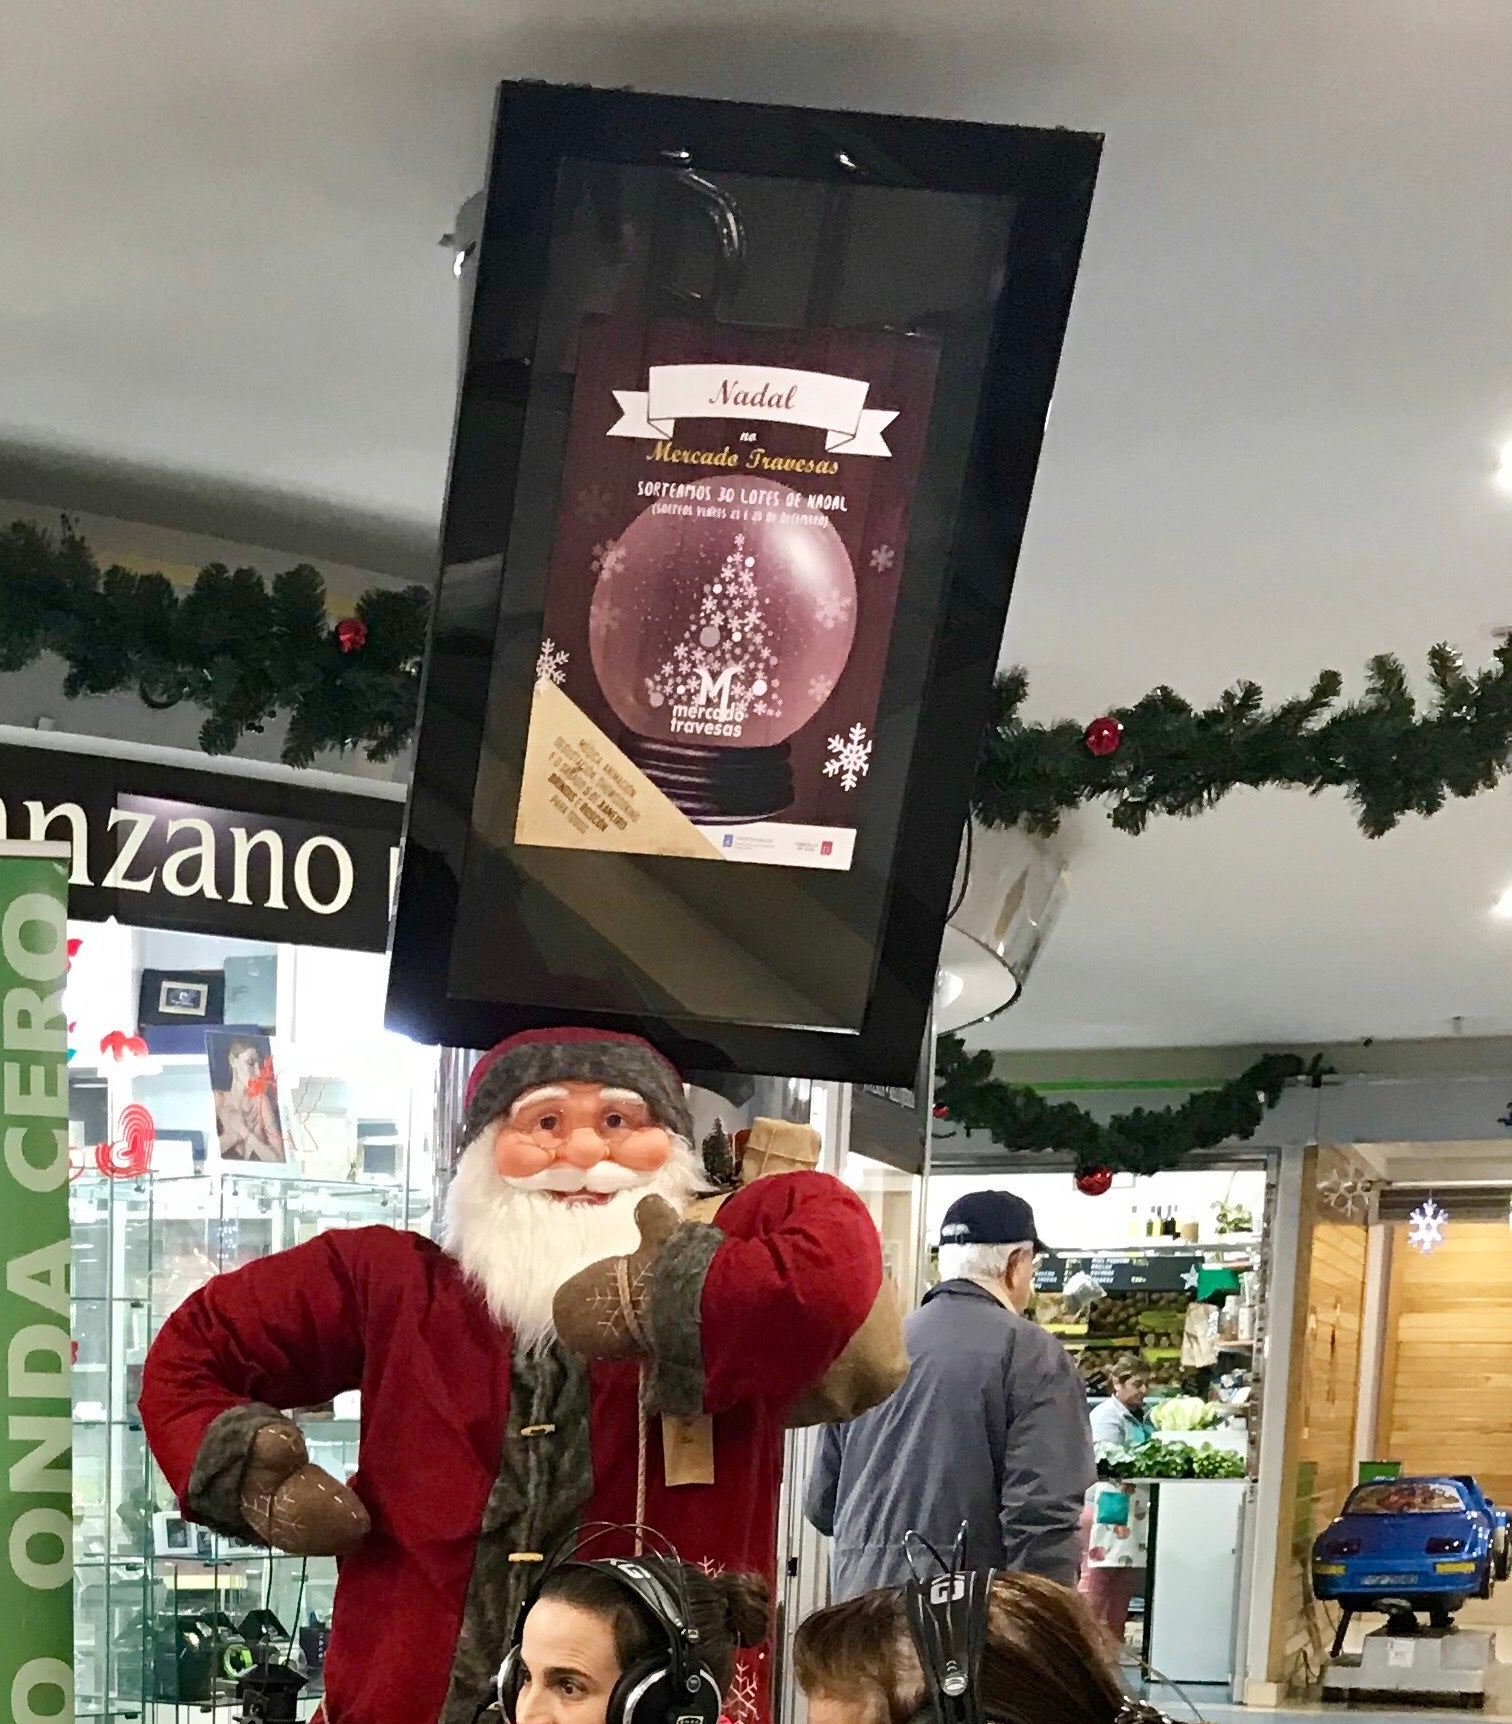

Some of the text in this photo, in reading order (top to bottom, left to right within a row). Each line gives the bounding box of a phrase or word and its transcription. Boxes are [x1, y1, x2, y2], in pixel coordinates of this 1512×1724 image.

[708, 379, 799, 410] Nadal
[646, 441, 839, 475] Mercado Travesas
[637, 481, 848, 512] SORTEAMOS 30 LOTES DE NADAL
[670, 717, 742, 738] travesas
[2, 892, 71, 1193] CERO
[7, 1239, 75, 1590] ONDA
